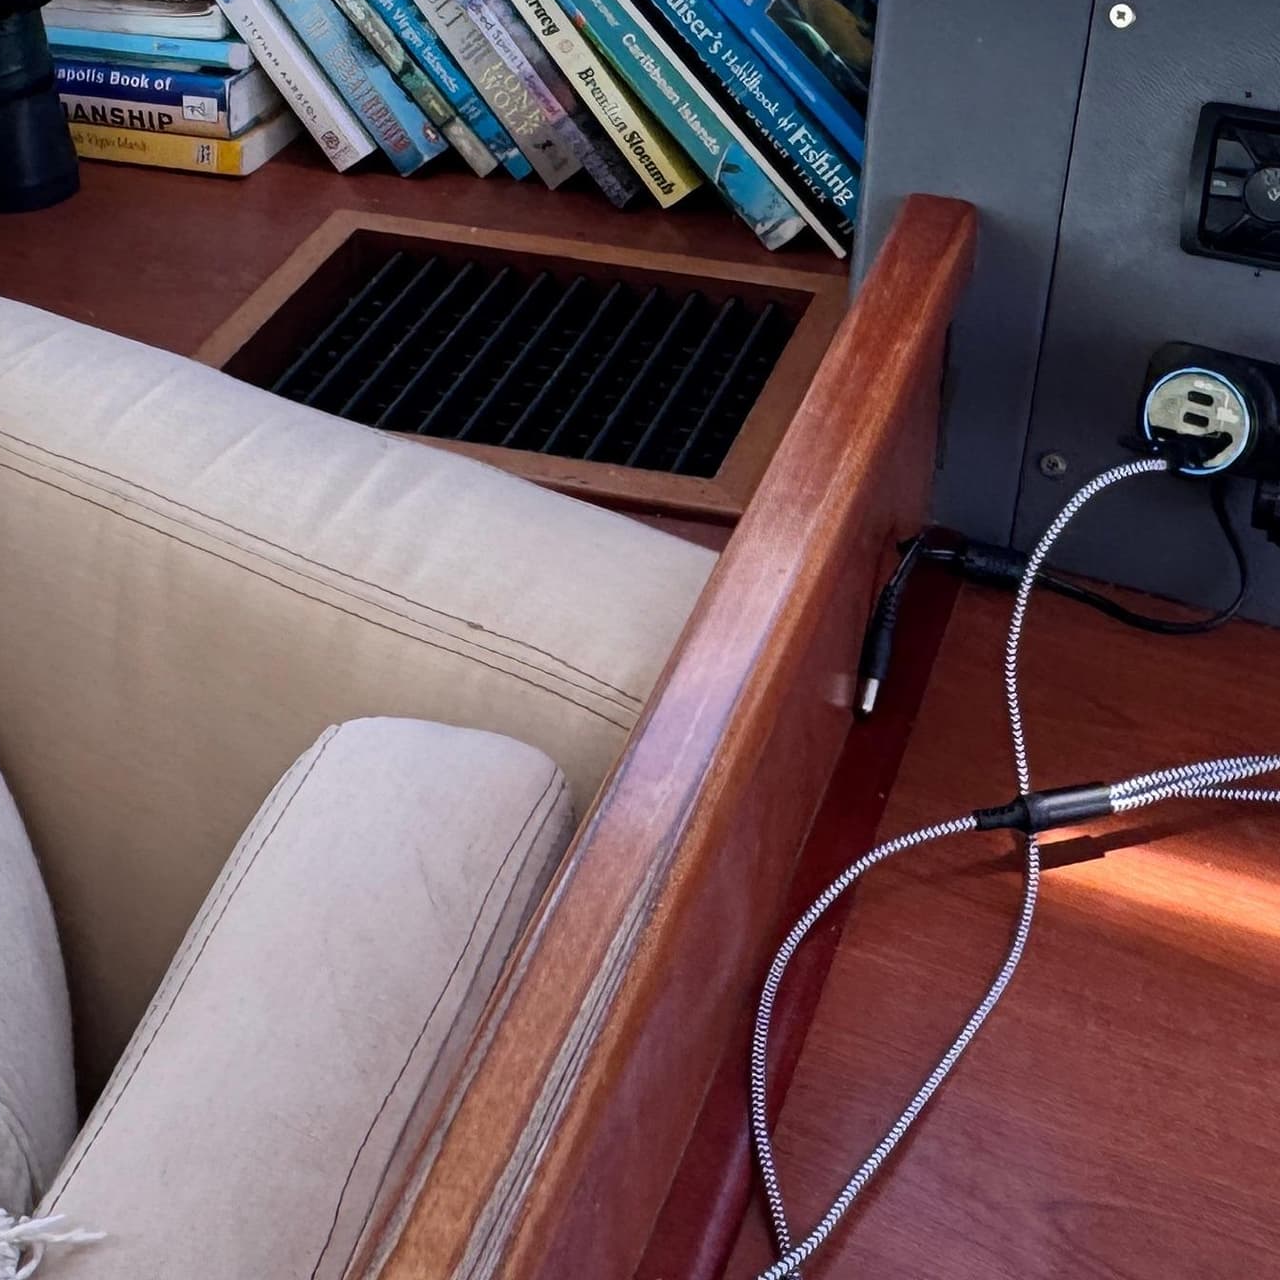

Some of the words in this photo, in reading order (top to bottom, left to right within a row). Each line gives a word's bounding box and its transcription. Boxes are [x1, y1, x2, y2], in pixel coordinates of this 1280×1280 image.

[109, 70, 150, 89] Book
[153, 77, 173, 91] of
[392, 6, 424, 49] Virgin
[421, 46, 460, 94] Islands
[480, 67, 534, 136] WOLF
[622, 32, 680, 106] Caribbean
[677, 102, 721, 156] Islands
[721, 49, 780, 118] Handbook
[776, 113, 798, 132] of
[787, 122, 854, 208] Fishing
[623, 129, 674, 196] Slocumb
